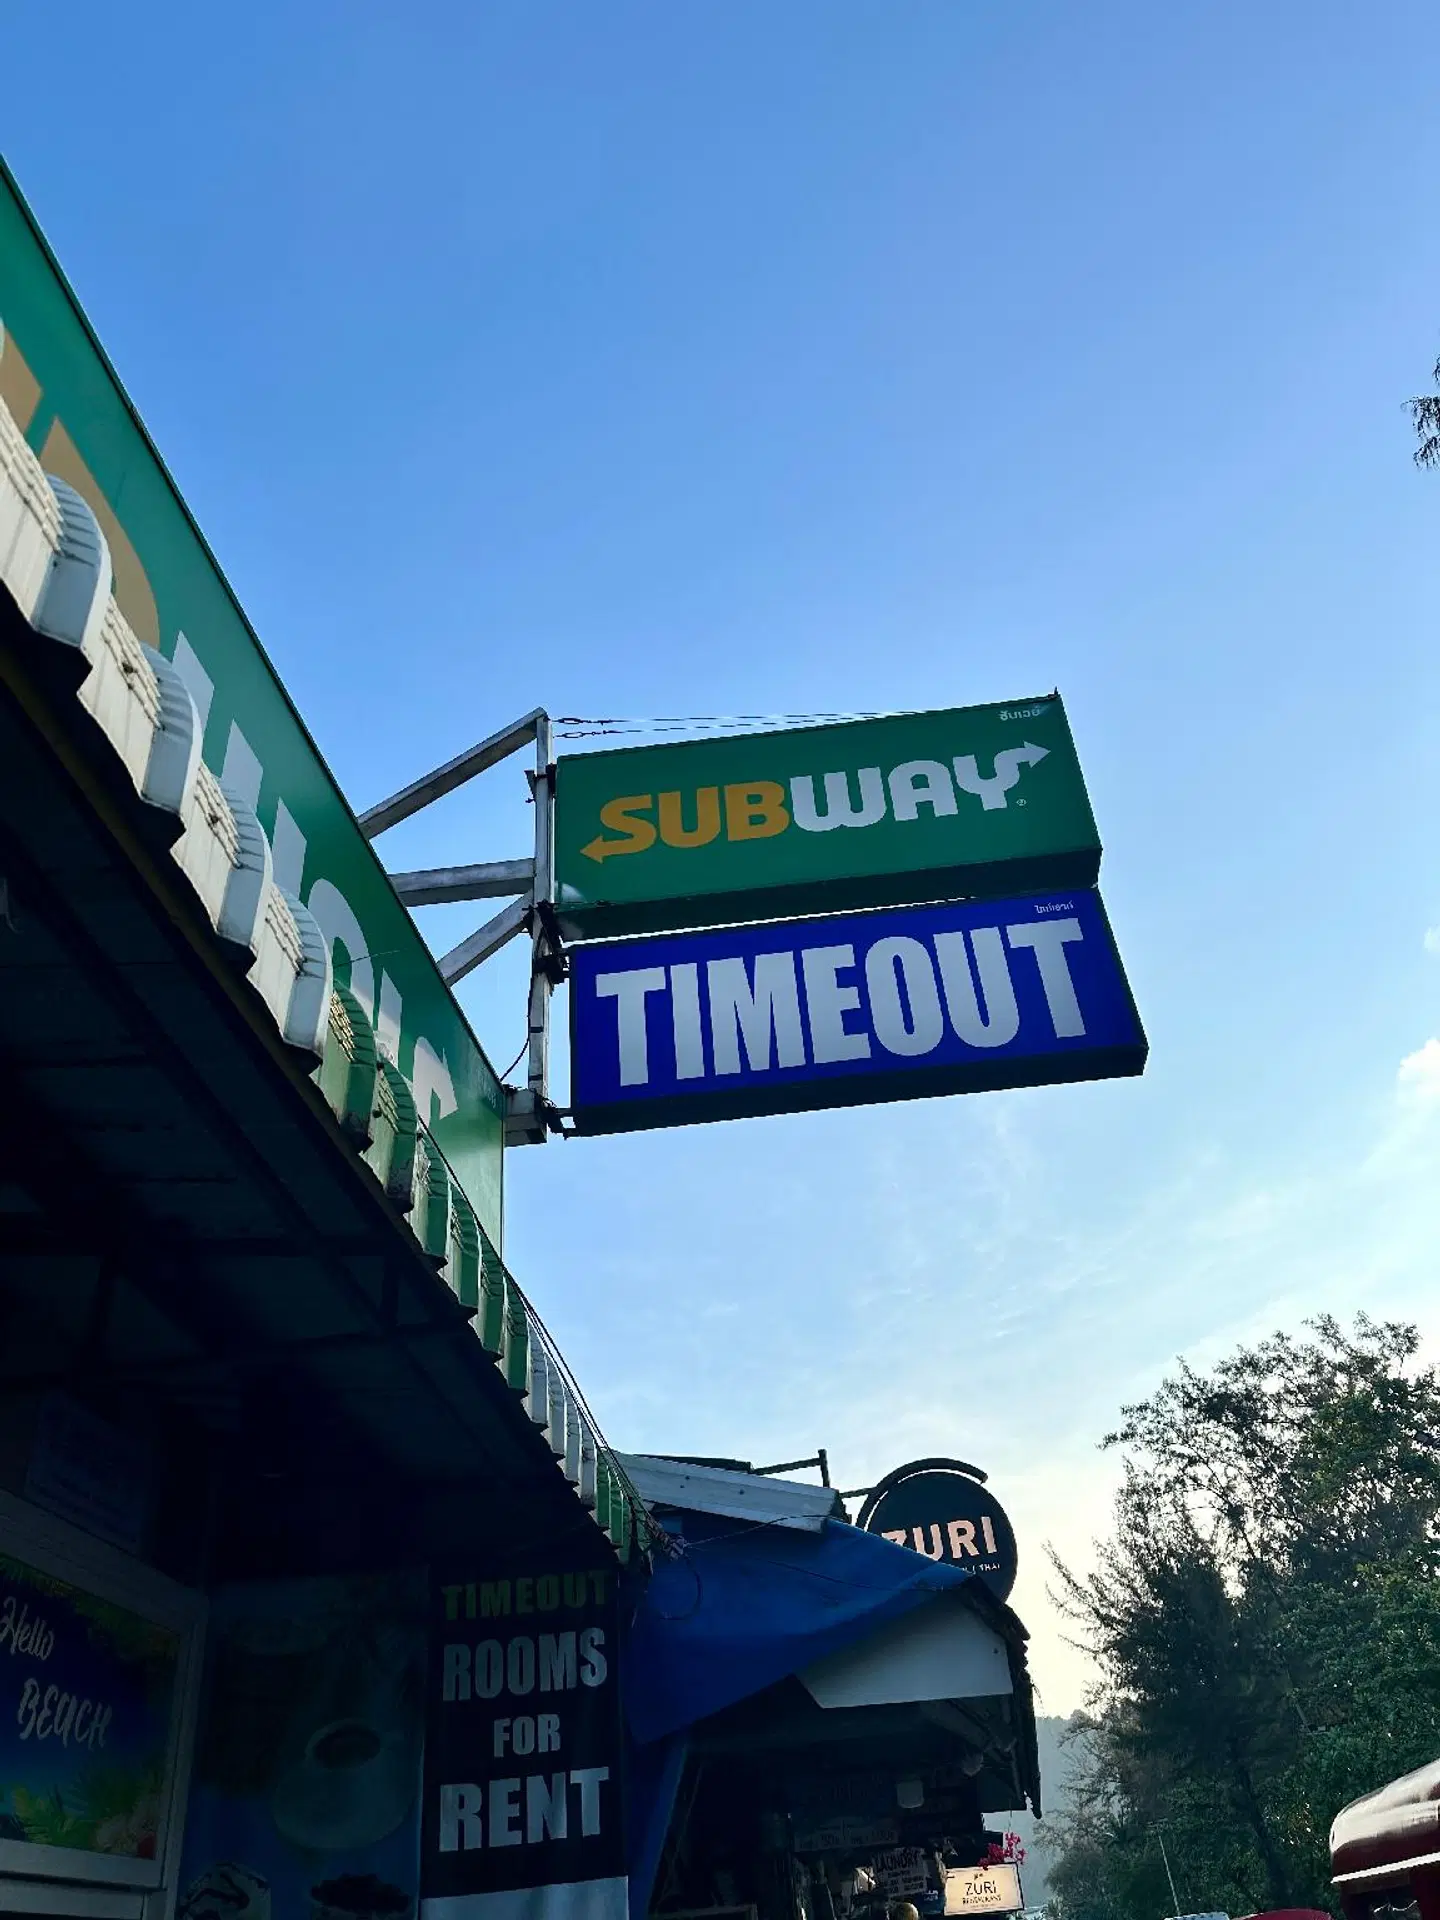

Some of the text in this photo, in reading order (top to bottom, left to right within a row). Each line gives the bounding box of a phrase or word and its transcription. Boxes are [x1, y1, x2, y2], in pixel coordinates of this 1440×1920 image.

[580, 741, 1051, 863] SUBWAY
[596, 918, 1087, 1087] TIMEOUT
[0, 1596, 55, 1661] Hello
[441, 1570, 610, 1621] TIMEOUT
[442, 1627, 608, 1702] ROOMS
[17, 1677, 113, 1751] BEACH
[493, 1713, 562, 1759] FOR
[439, 1766, 610, 1853] RENT
